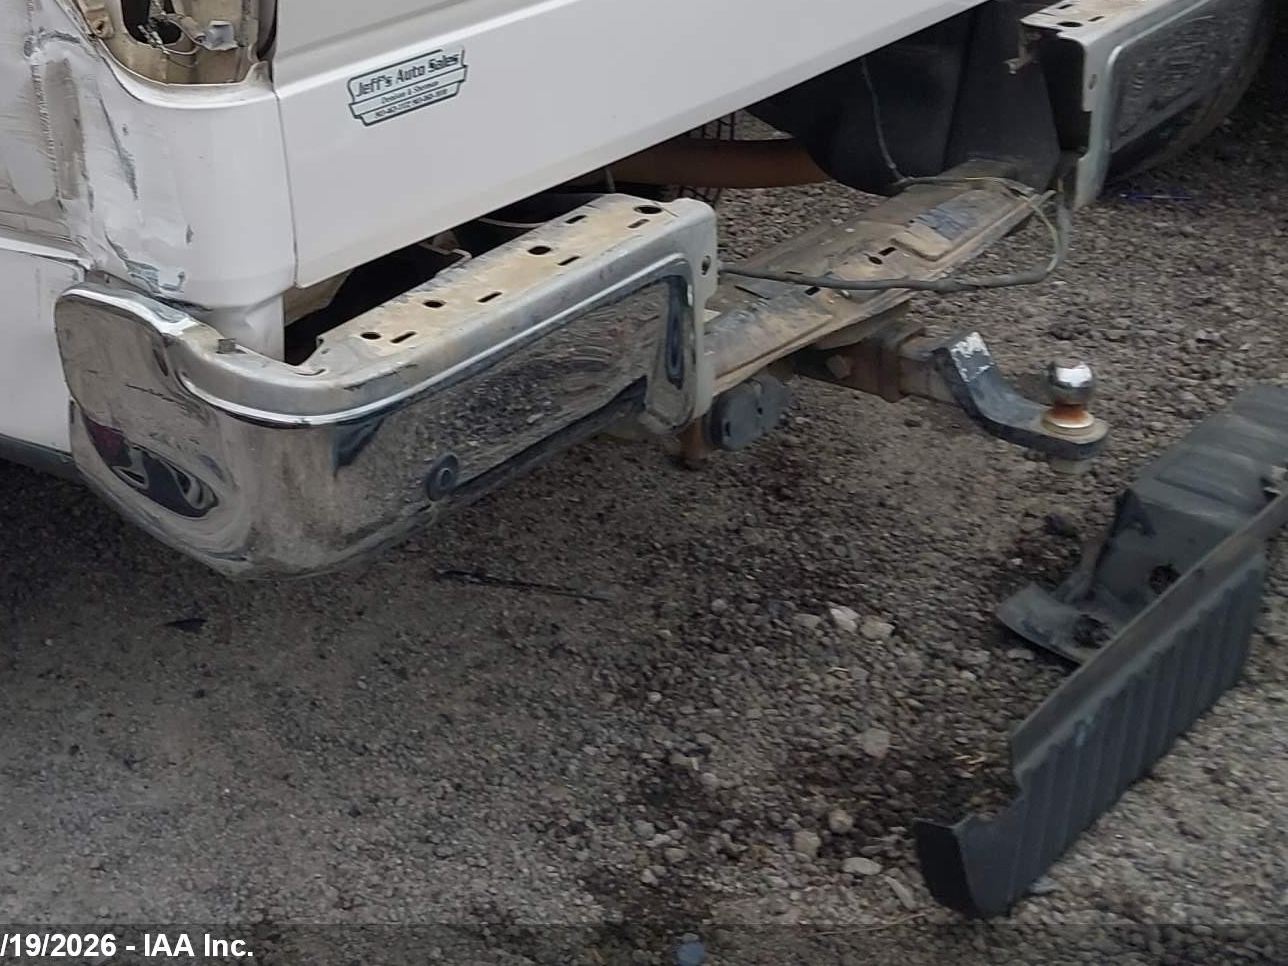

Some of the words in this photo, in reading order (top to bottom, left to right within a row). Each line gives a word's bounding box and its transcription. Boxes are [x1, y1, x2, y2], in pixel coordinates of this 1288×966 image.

[356, 75, 393, 97] Jeff's
[396, 65, 426, 83] Auto
[428, 54, 460, 73] Sales
